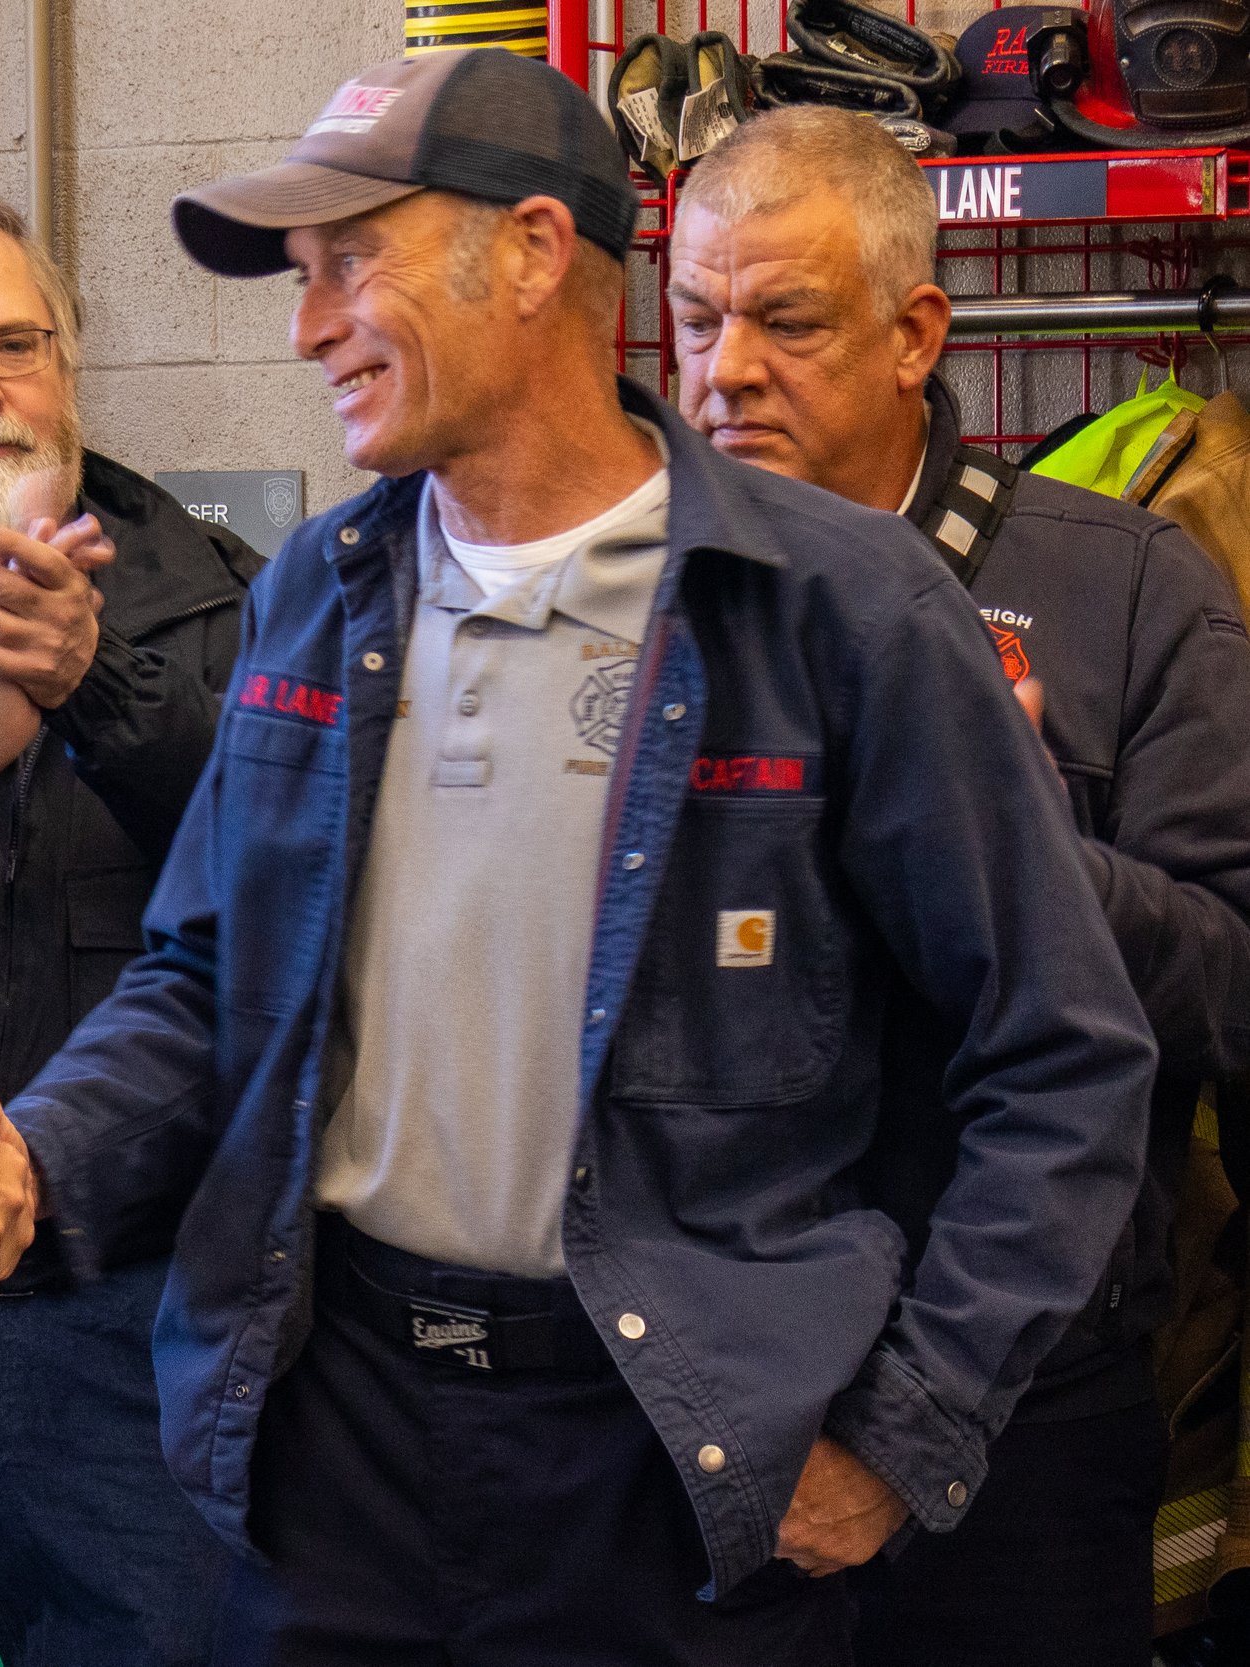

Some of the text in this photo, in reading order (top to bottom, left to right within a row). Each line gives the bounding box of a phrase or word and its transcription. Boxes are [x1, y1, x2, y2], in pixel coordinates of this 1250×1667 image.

[987, 26, 1028, 57] RA
[981, 60, 1030, 75] FIRE
[938, 166, 1022, 220] LANE
[182, 504, 229, 524] SER
[979, 608, 1034, 629] EIGH
